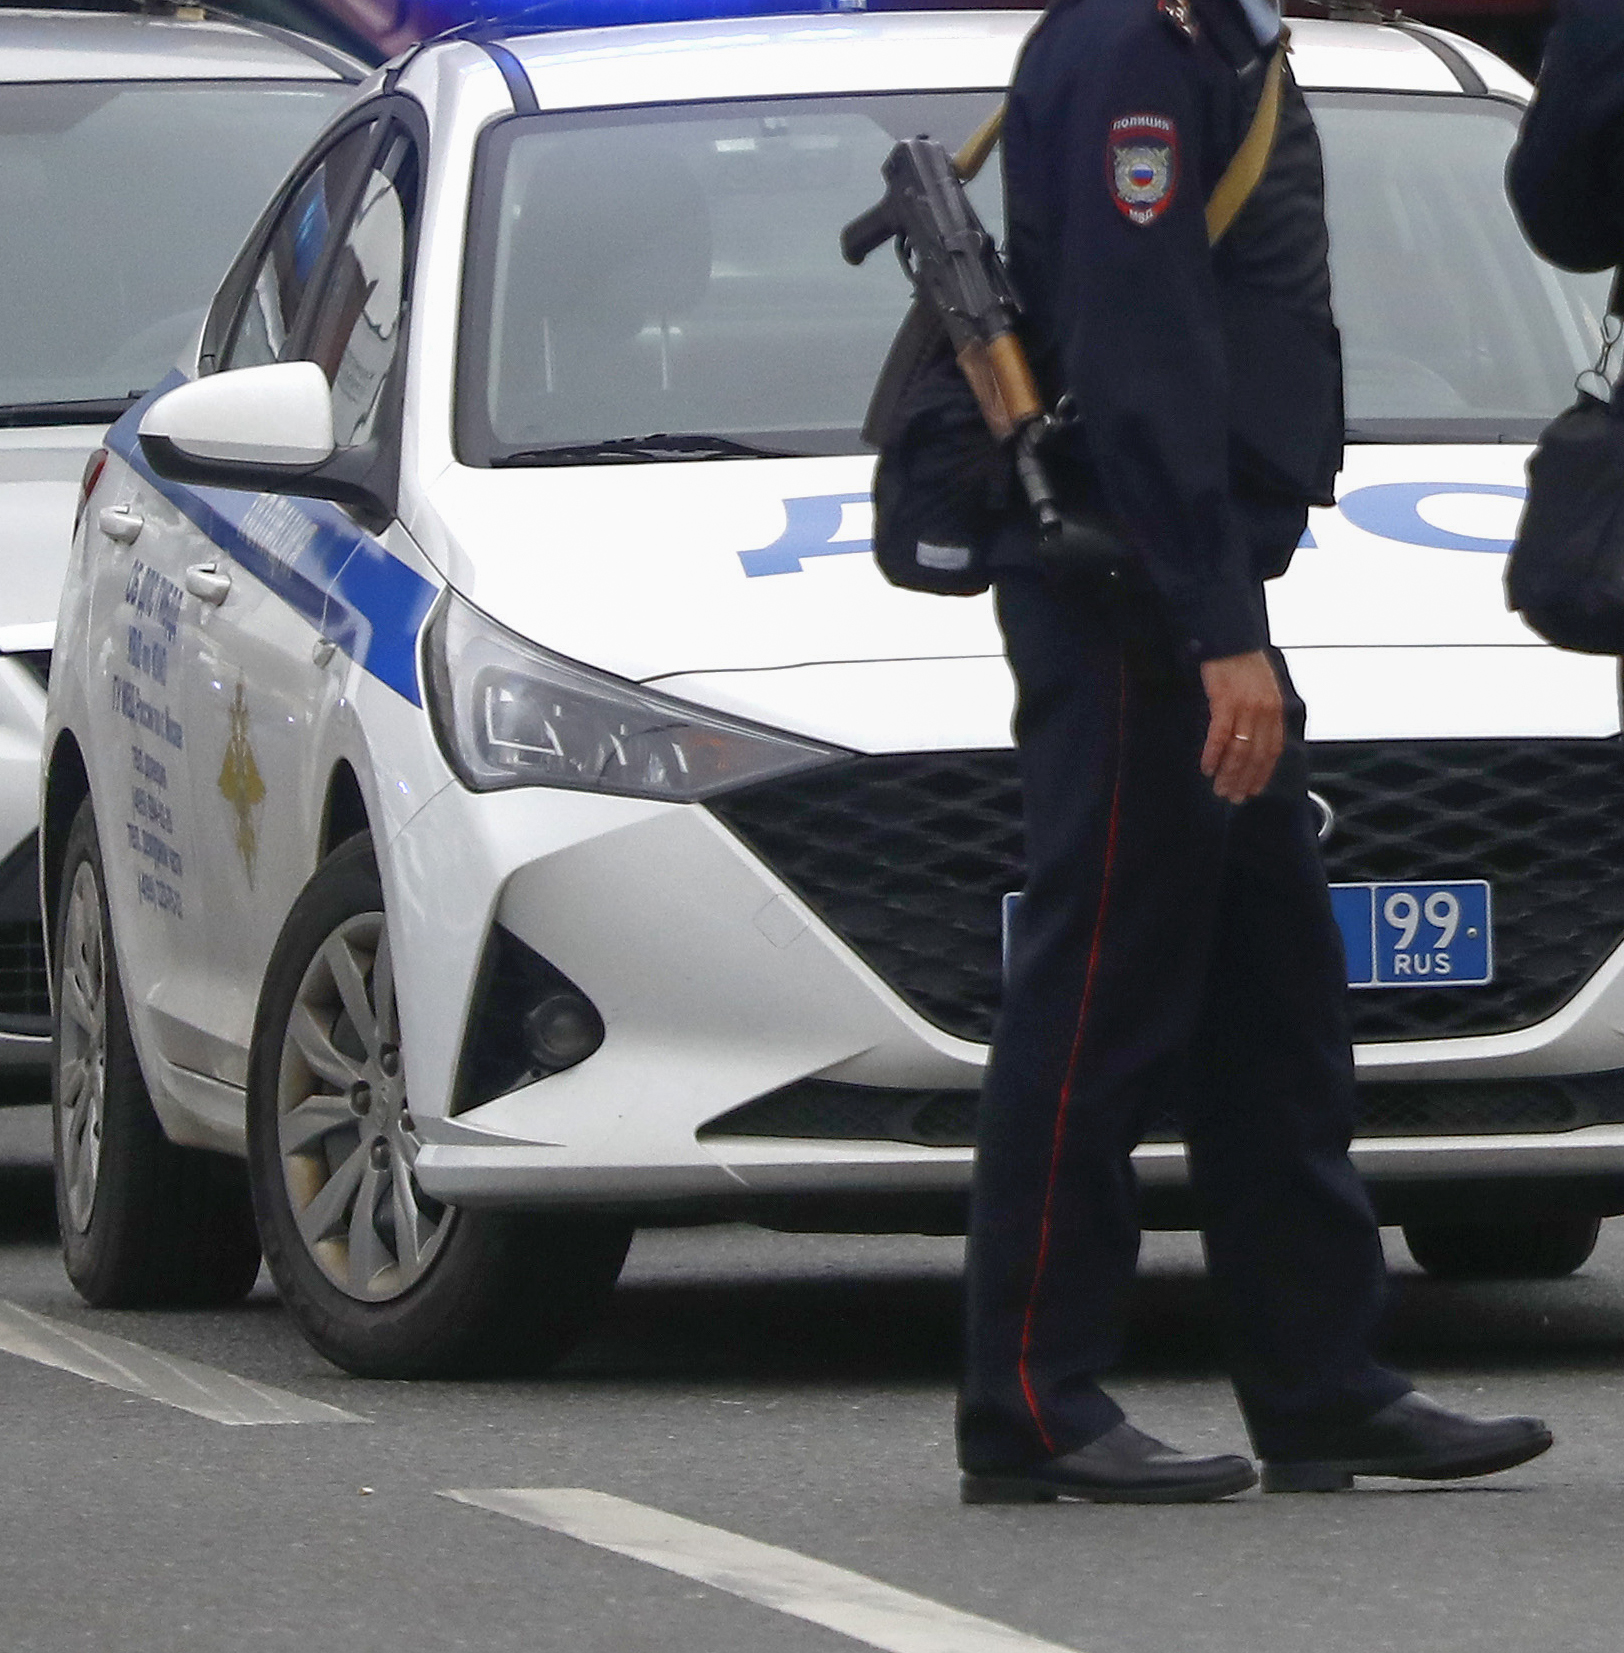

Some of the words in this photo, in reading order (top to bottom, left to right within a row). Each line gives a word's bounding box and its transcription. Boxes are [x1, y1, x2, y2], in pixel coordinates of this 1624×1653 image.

[1112, 115, 1170, 131] ПОЛИЦИЯ
[1382, 891, 1461, 952] 99
[1393, 952, 1452, 977] RUS
